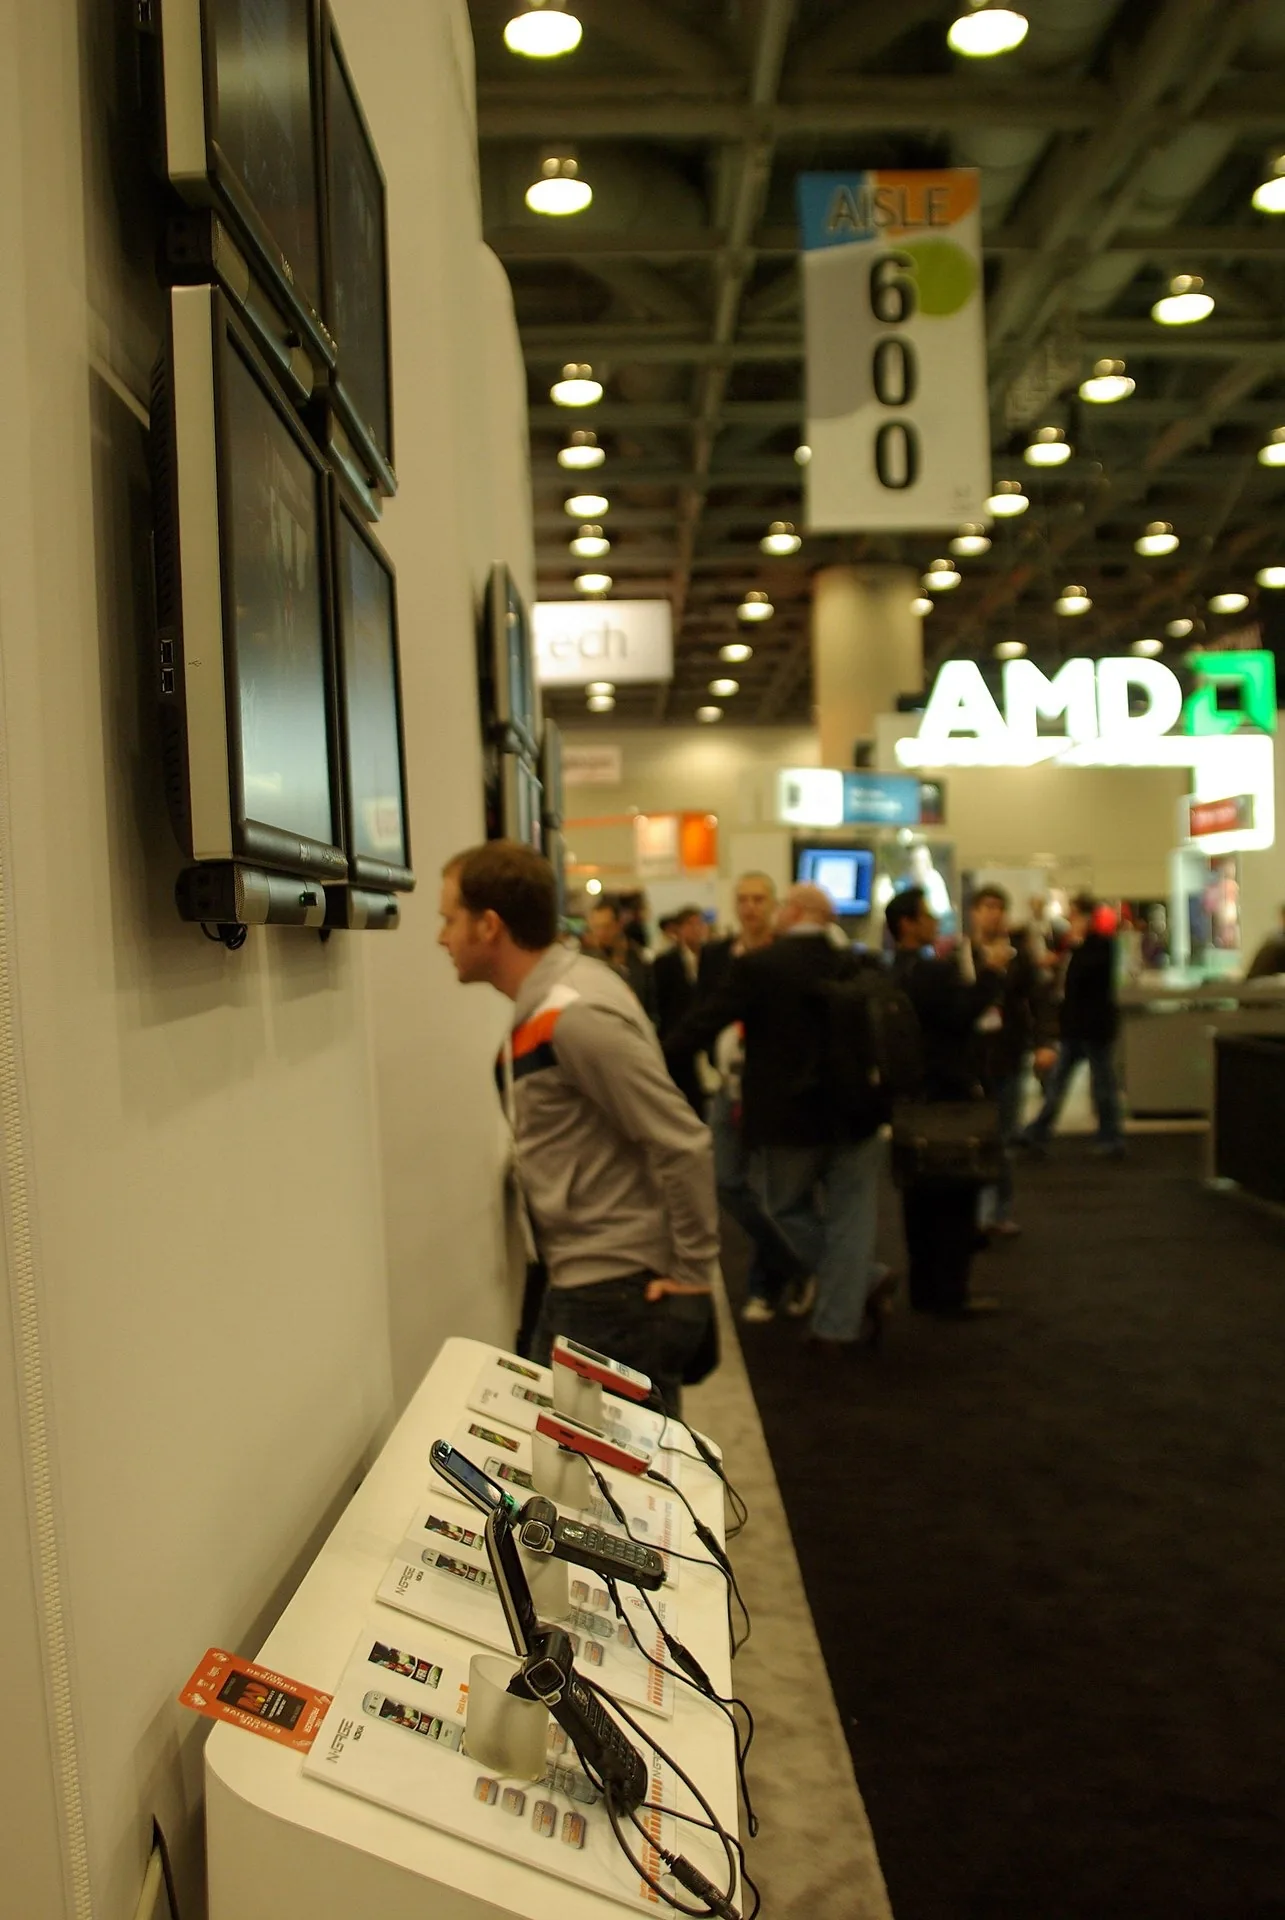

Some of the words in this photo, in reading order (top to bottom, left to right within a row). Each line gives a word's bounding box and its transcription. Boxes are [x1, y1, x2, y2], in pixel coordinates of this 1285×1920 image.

[828, 185, 951, 230] AISLE
[869, 253, 920, 490] 600
[916, 657, 1183, 738] AMD
[247, 1668, 297, 1692] DESIGNER
[223, 1706, 281, 1733] EXECUTIVE
